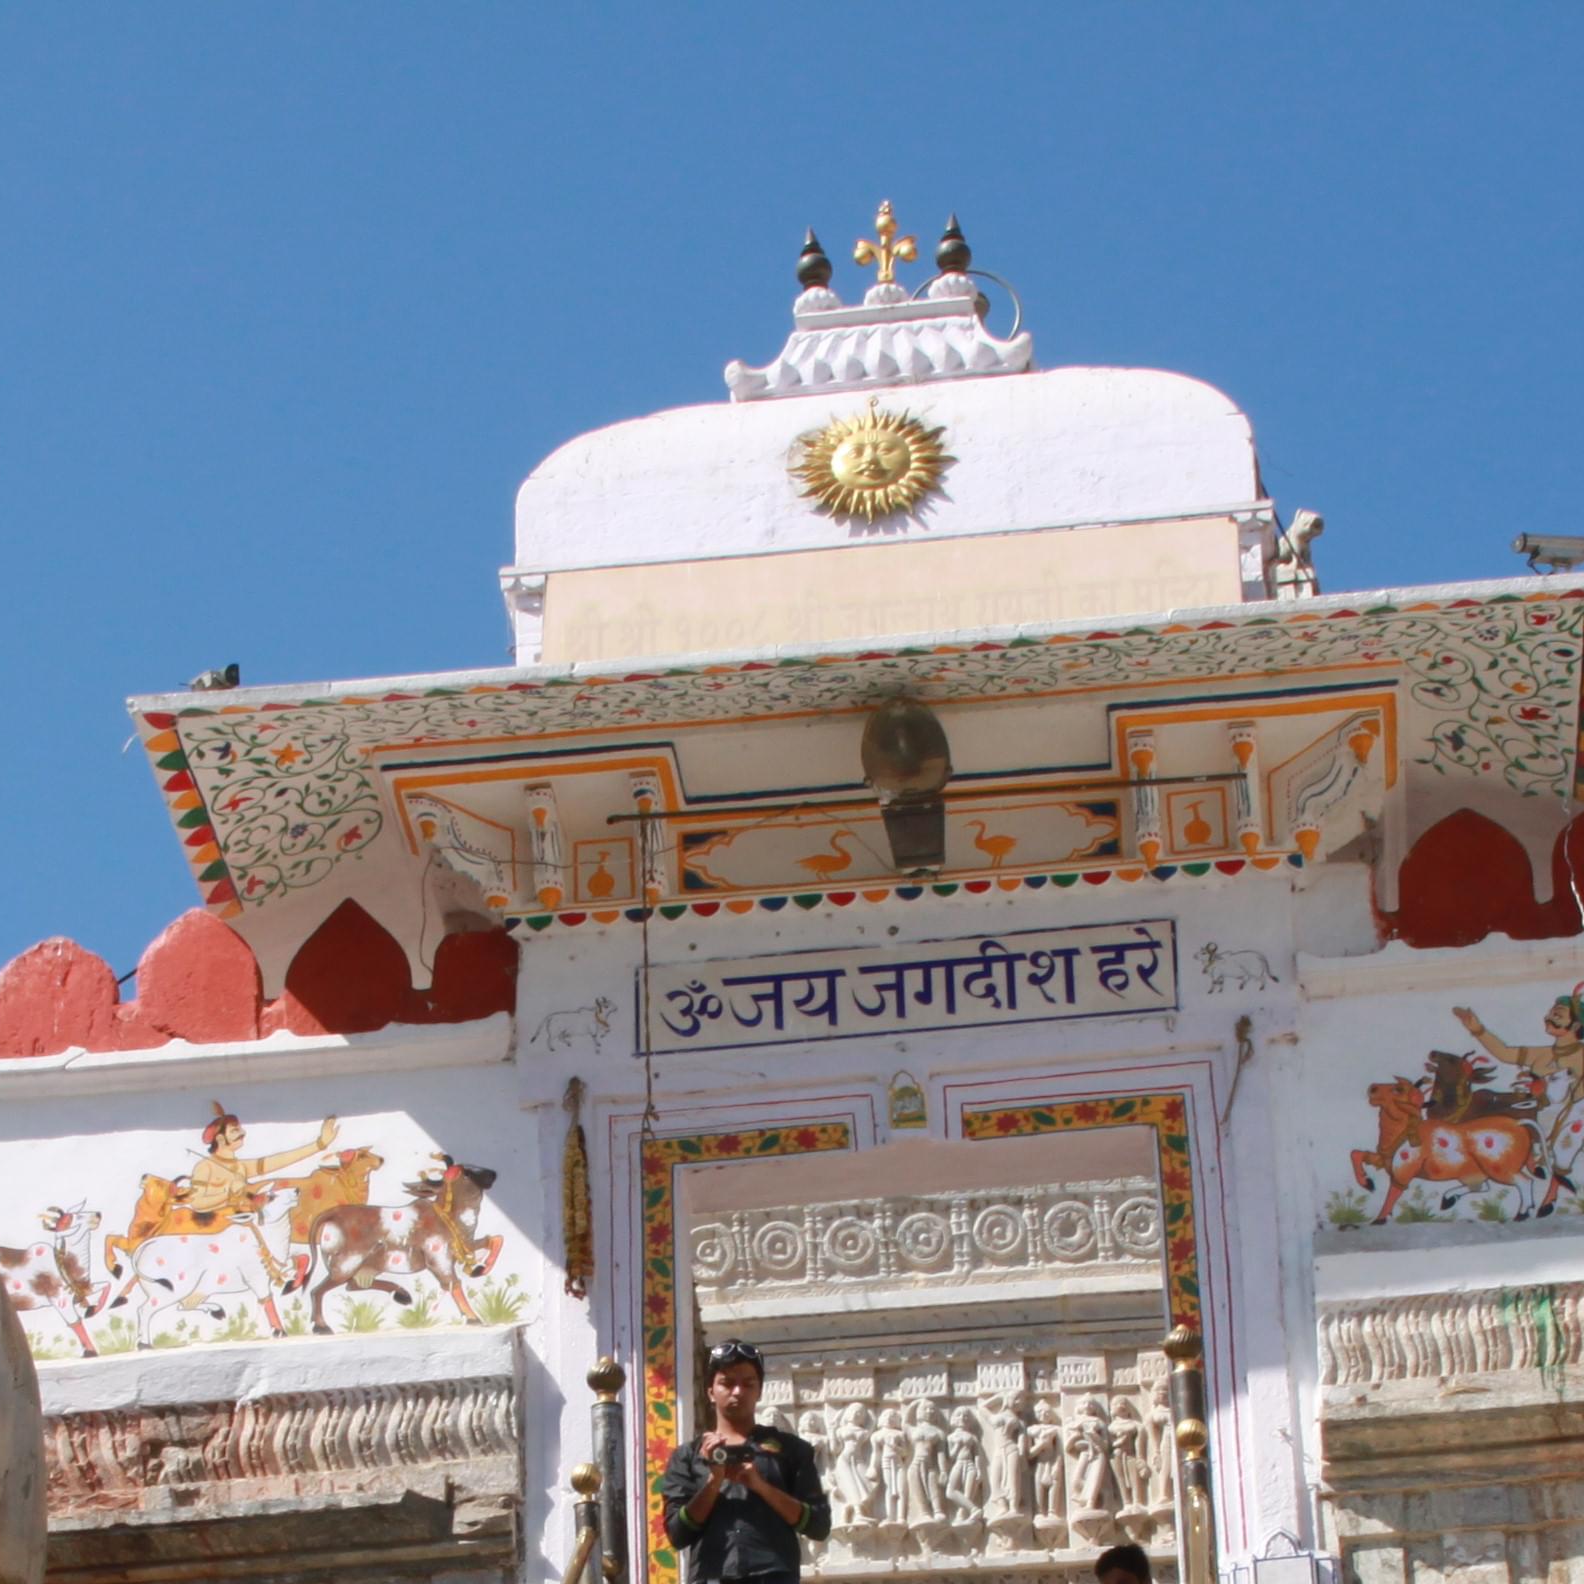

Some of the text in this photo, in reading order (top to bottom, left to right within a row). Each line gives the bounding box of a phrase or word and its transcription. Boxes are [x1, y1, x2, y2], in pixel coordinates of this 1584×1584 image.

[723, 968, 846, 1031] जय
[853, 940, 1081, 1019] जगदीश
[1090, 928, 1163, 997] हरे
